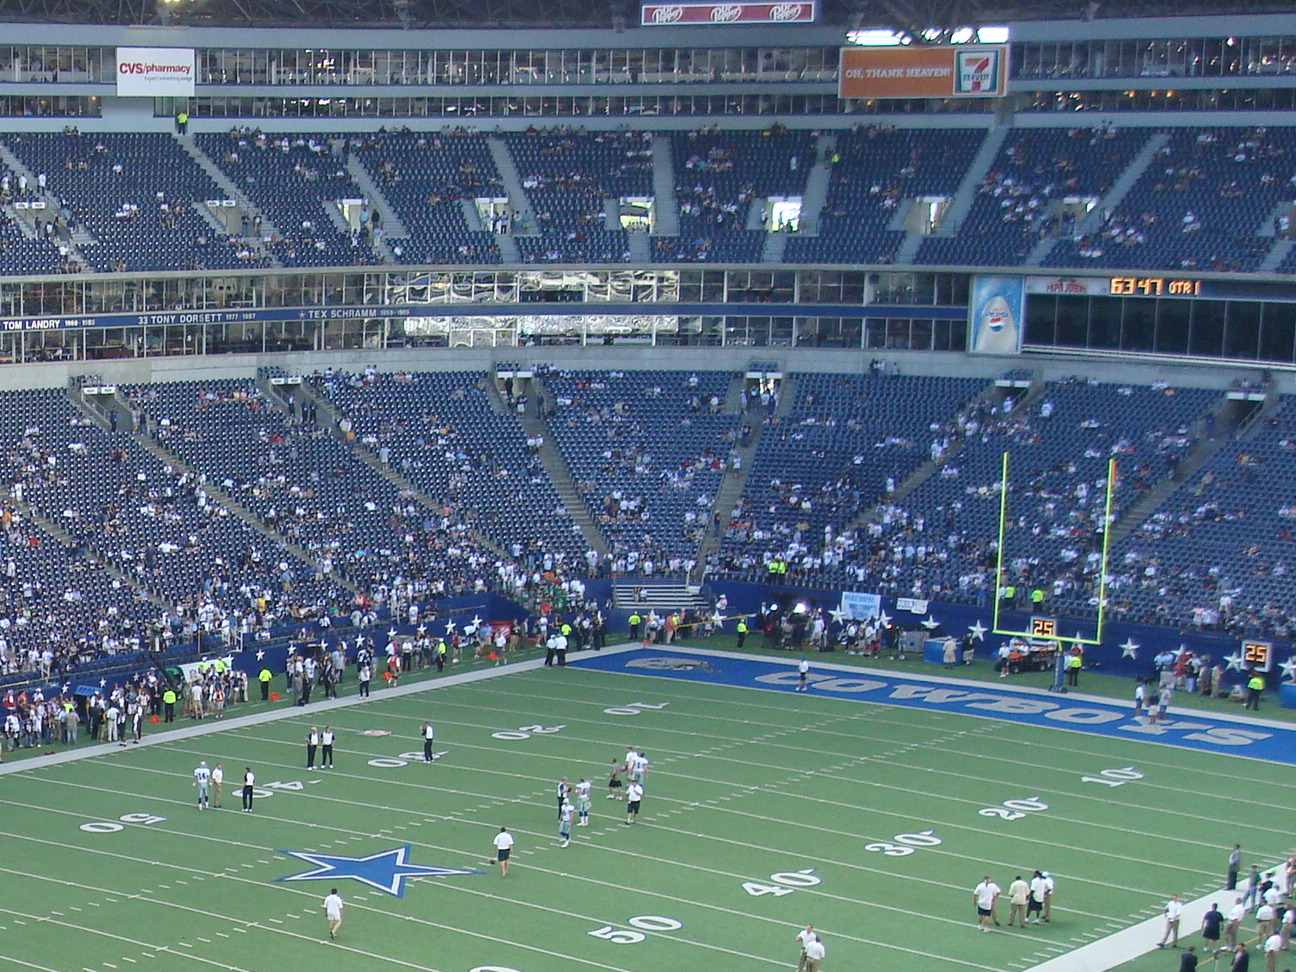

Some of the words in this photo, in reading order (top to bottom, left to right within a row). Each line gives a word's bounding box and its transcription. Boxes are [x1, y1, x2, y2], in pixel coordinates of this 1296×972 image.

[652, 9, 682, 23] Pepper
[711, 8, 741, 22] Pepper
[769, 7, 801, 22] Pepper
[866, 69, 904, 79] THANK
[138, 315, 148, 325] 33
[150, 314, 176, 324] TONY
[179, 313, 223, 323] DORSETT
[308, 310, 327, 319] TEX
[330, 308, 377, 318] SCHRAMM
[3, 320, 23, 331] TOM
[26, 319, 61, 329] LANDRY
[1033, 620, 1054, 636] 25
[1245, 644, 1267, 663] 25
[604, 702, 664, 716] 10
[753, 671, 1275, 748] COWBOYS
[491, 724, 561, 740] 20
[1080, 767, 1145, 788] 10
[978, 796, 1050, 822] 20
[79, 812, 166, 833] 50
[863, 829, 943, 857] 30
[740, 868, 822, 897] 40
[587, 915, 684, 945] 50
